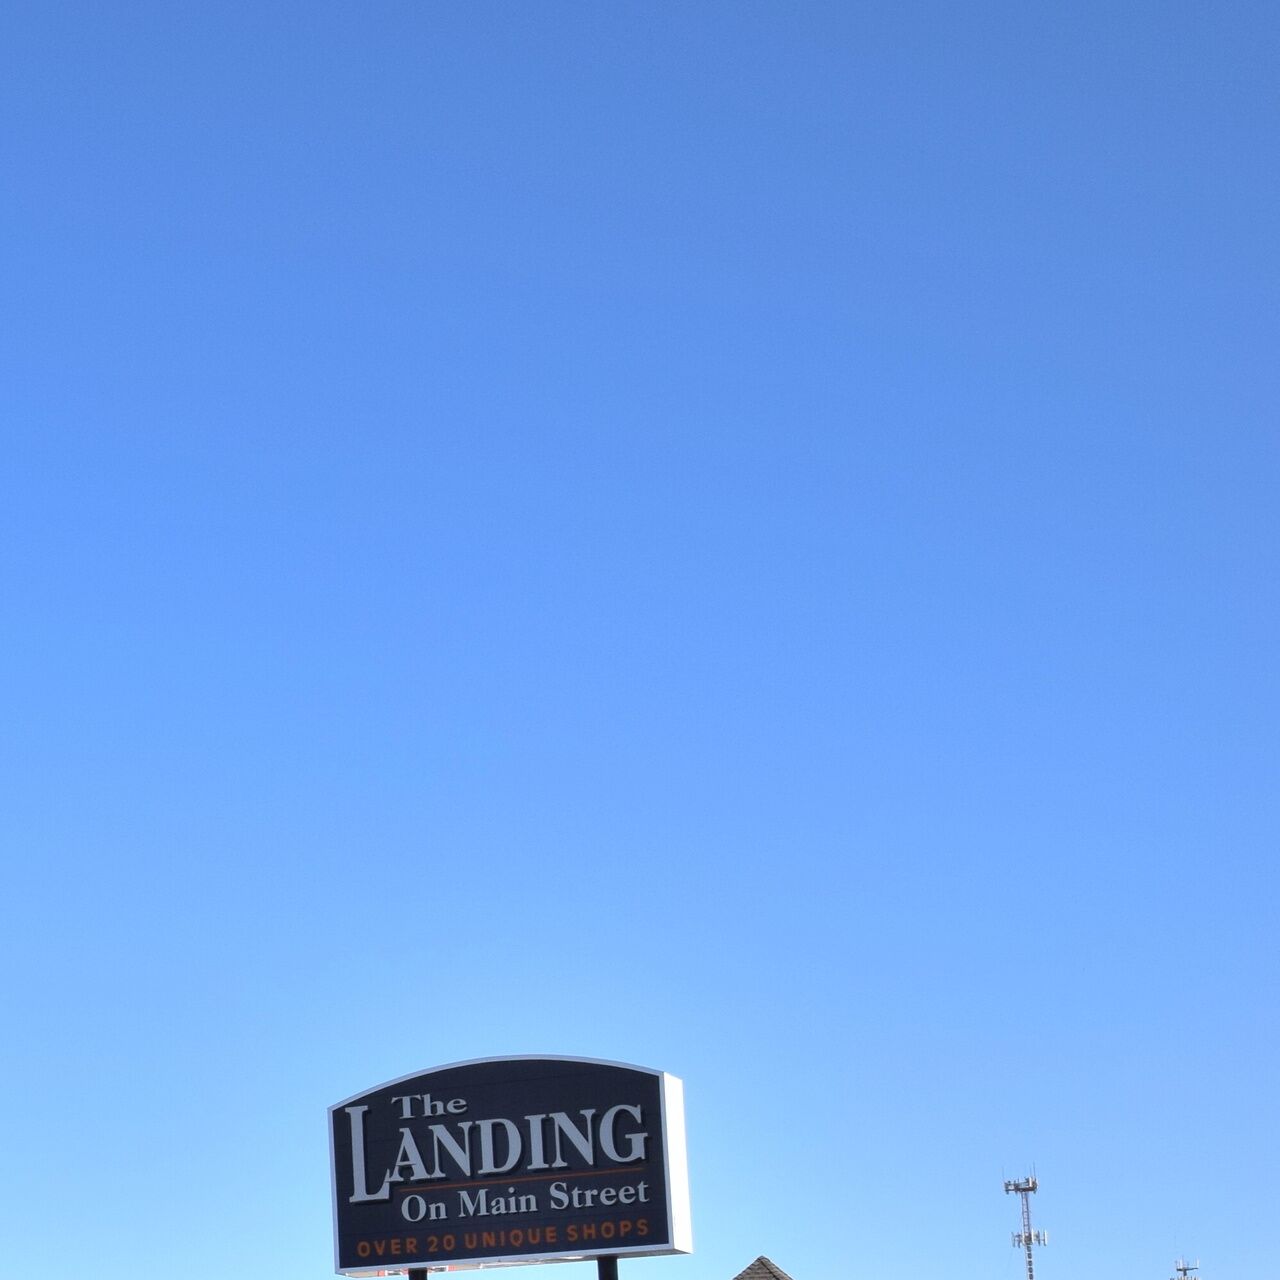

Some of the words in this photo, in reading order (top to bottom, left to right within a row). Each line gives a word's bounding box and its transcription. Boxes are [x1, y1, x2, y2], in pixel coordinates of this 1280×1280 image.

[391, 1093, 468, 1119] The
[345, 1103, 649, 1203] LANDING
[401, 1194, 448, 1222] On
[458, 1187, 538, 1218] Main
[549, 1180, 650, 1211] Street
[357, 1237, 419, 1258] OVER
[428, 1234, 457, 1252] 20
[464, 1226, 559, 1250] UNIQUE
[567, 1218, 650, 1242] SHOPS
